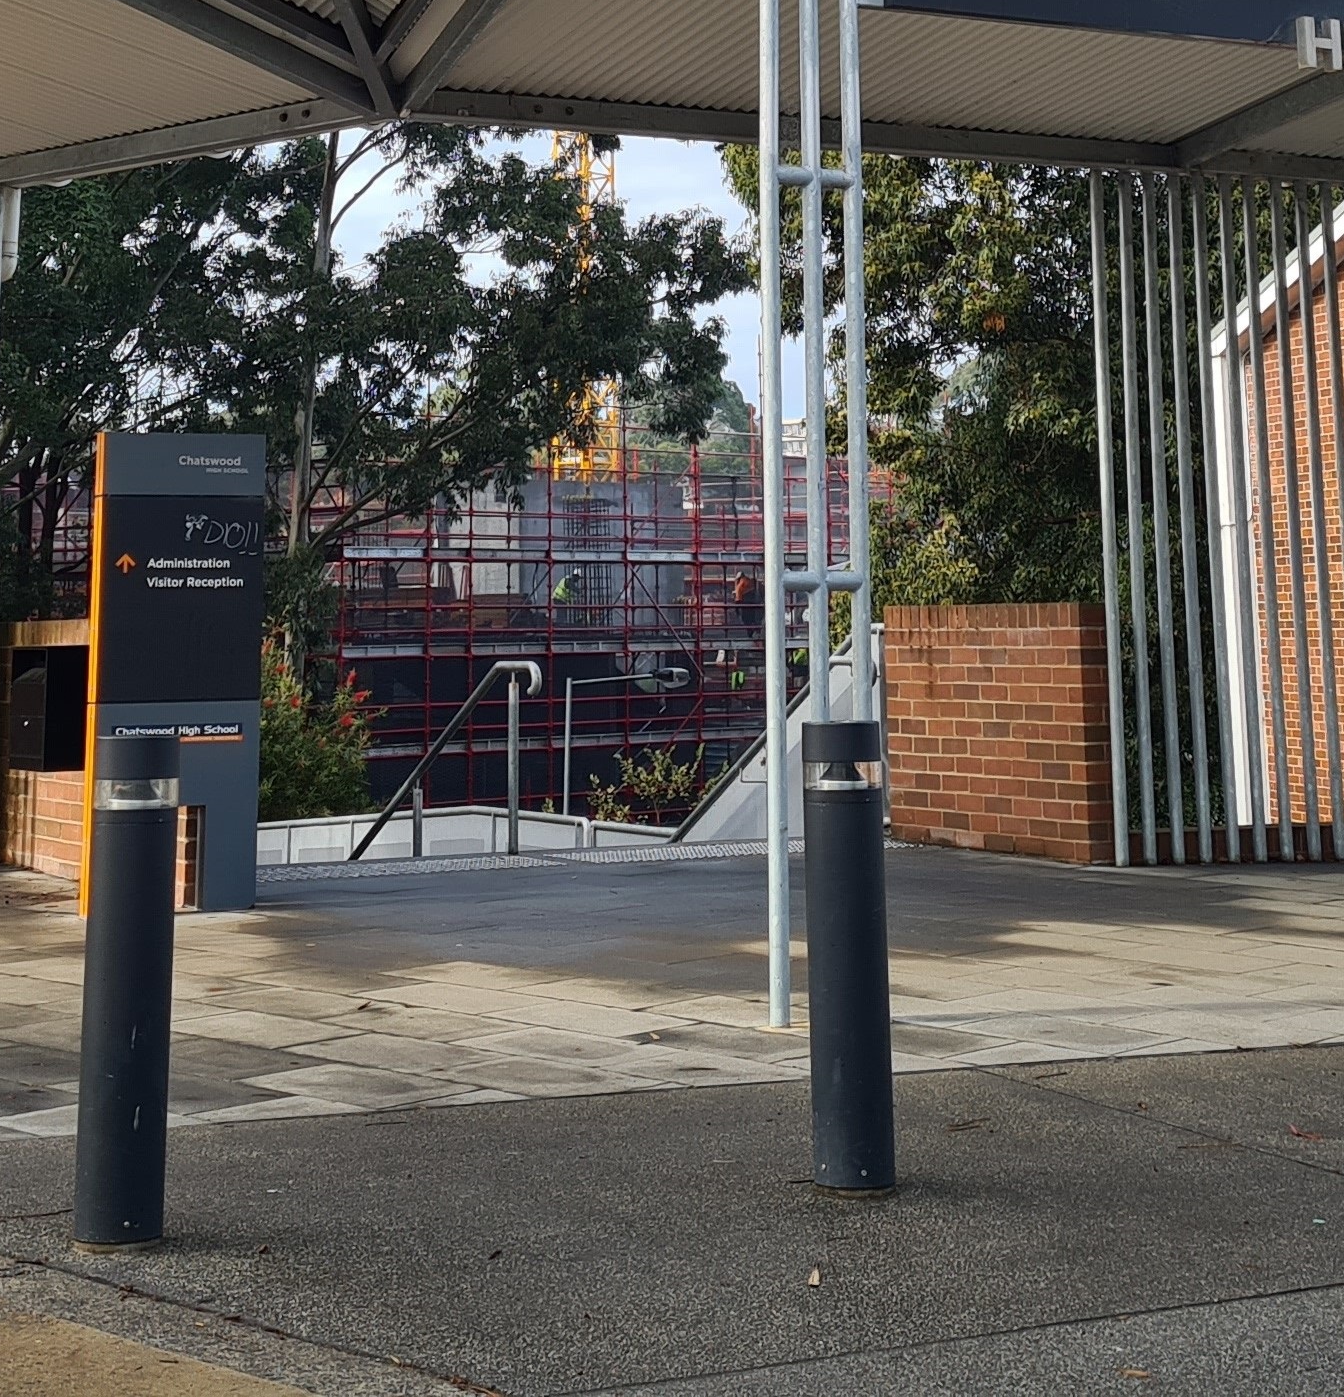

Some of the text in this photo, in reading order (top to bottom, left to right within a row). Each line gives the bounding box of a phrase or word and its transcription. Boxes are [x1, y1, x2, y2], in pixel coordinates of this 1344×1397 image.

[178, 455, 242, 466] Chatswood
[146, 557, 231, 569] Administration
[146, 576, 244, 589] Visitor Reception
[177, 725, 201, 737] High
[203, 724, 239, 735] School
